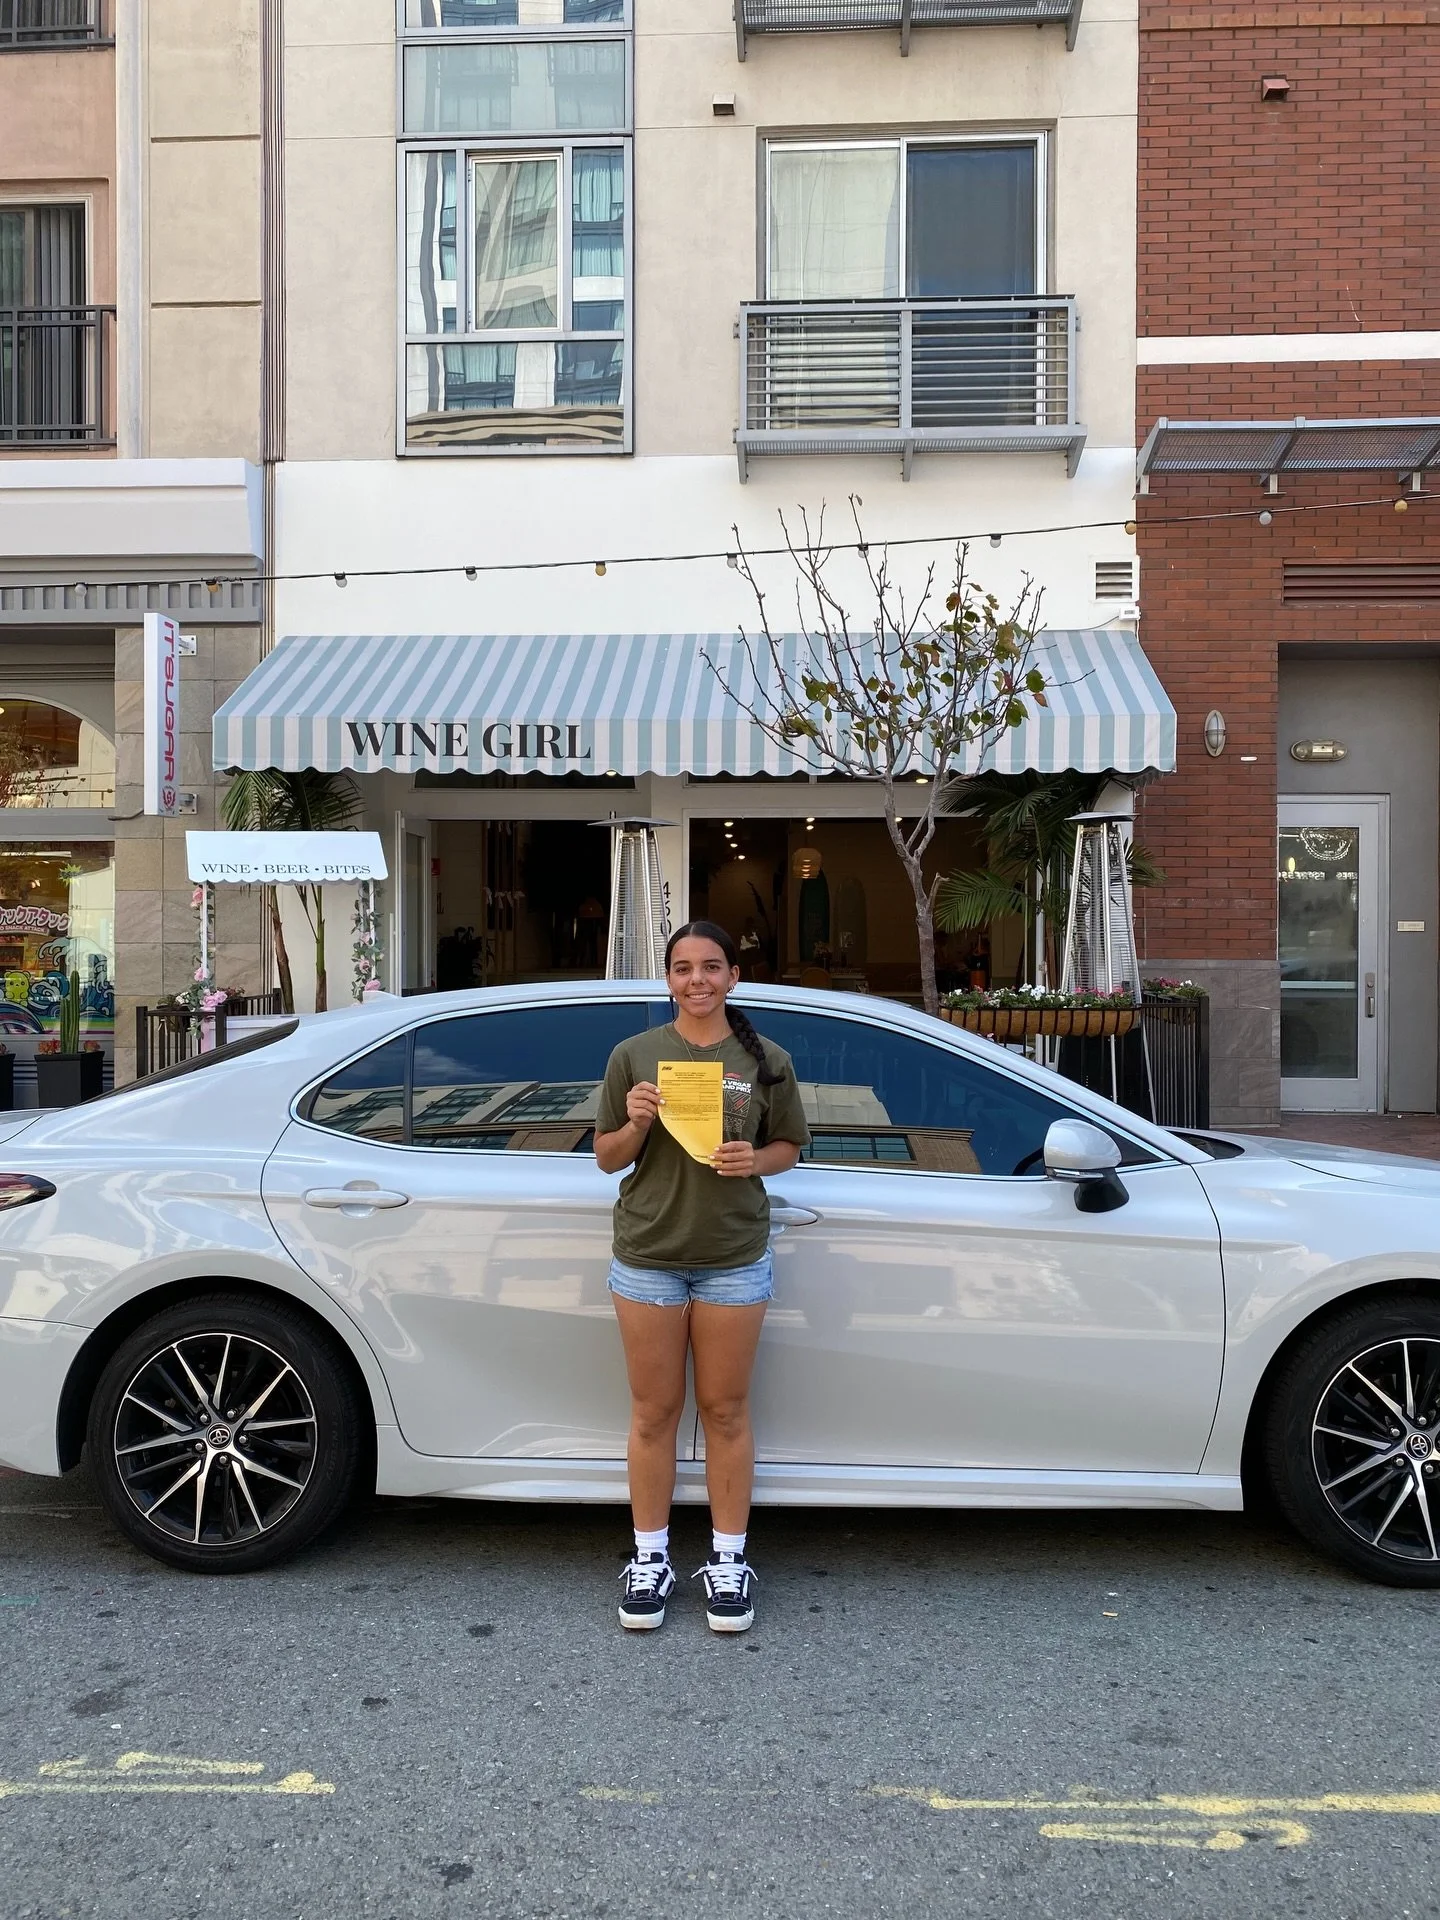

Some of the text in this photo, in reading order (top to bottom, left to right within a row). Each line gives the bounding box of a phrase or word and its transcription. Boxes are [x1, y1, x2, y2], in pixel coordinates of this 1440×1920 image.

[345, 722, 591, 759] WINE GIRL
[201, 863, 371, 874] WINE BEER BITES
[727, 1080, 752, 1088] VEGAS
